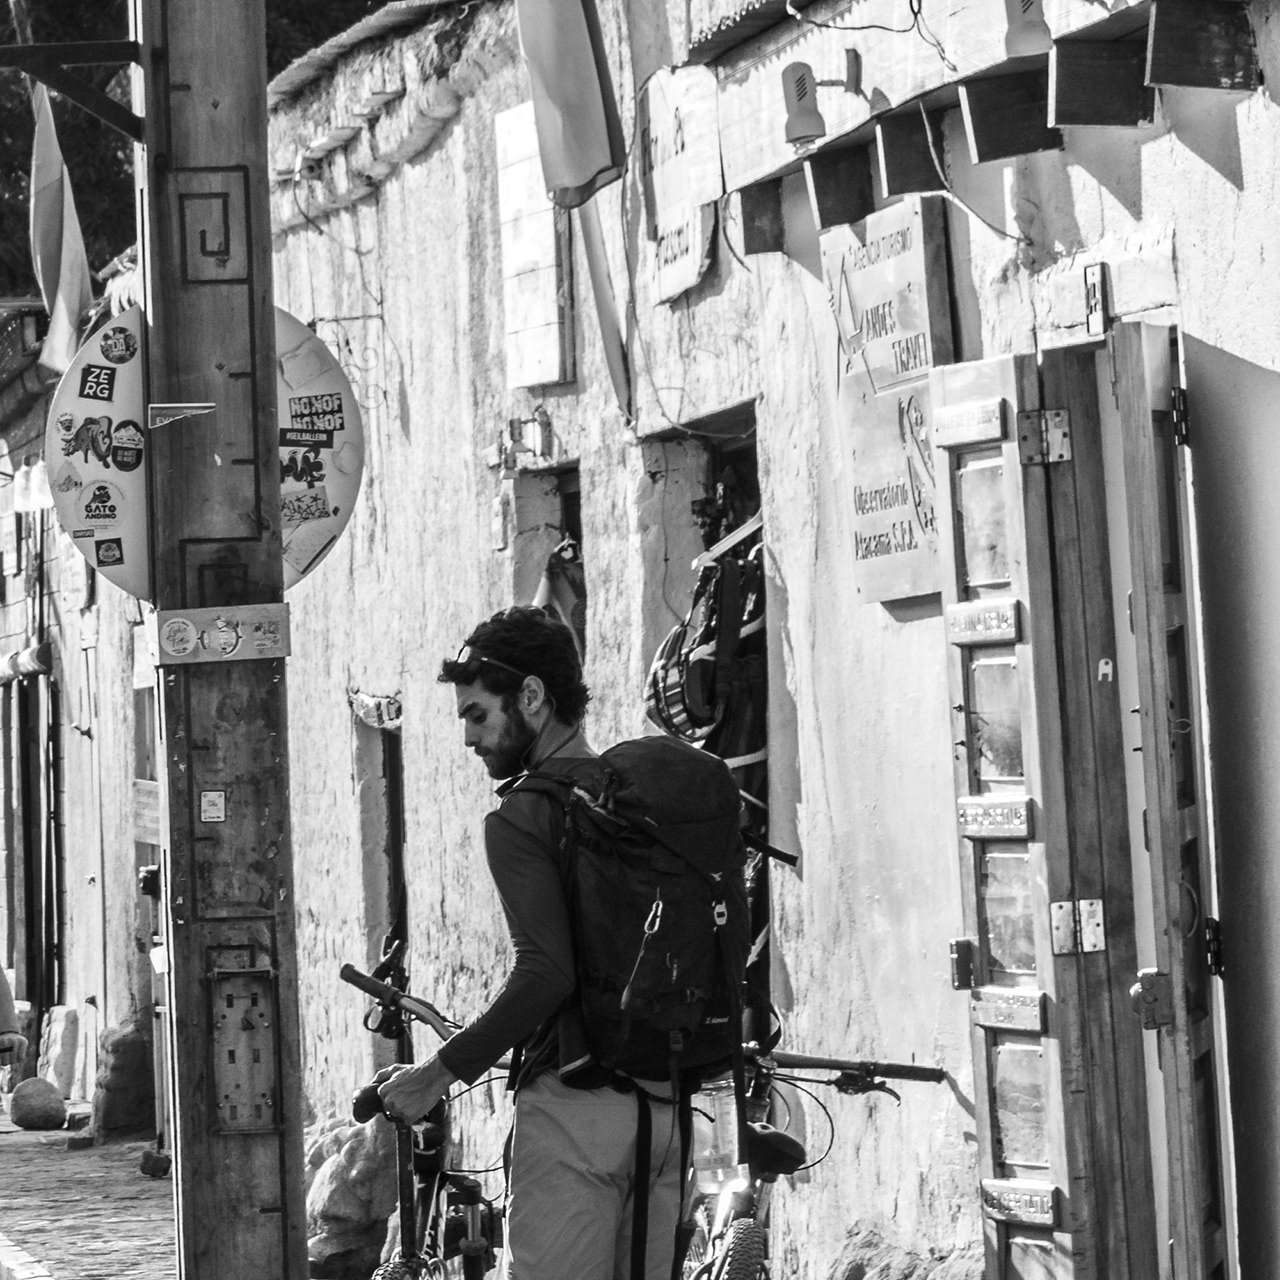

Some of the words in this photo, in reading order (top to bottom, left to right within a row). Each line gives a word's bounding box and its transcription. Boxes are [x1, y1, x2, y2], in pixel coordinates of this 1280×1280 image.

[892, 332, 929, 374] TRAVEL
[85, 504, 117, 513] GATO
[854, 480, 908, 516] Observatorio
